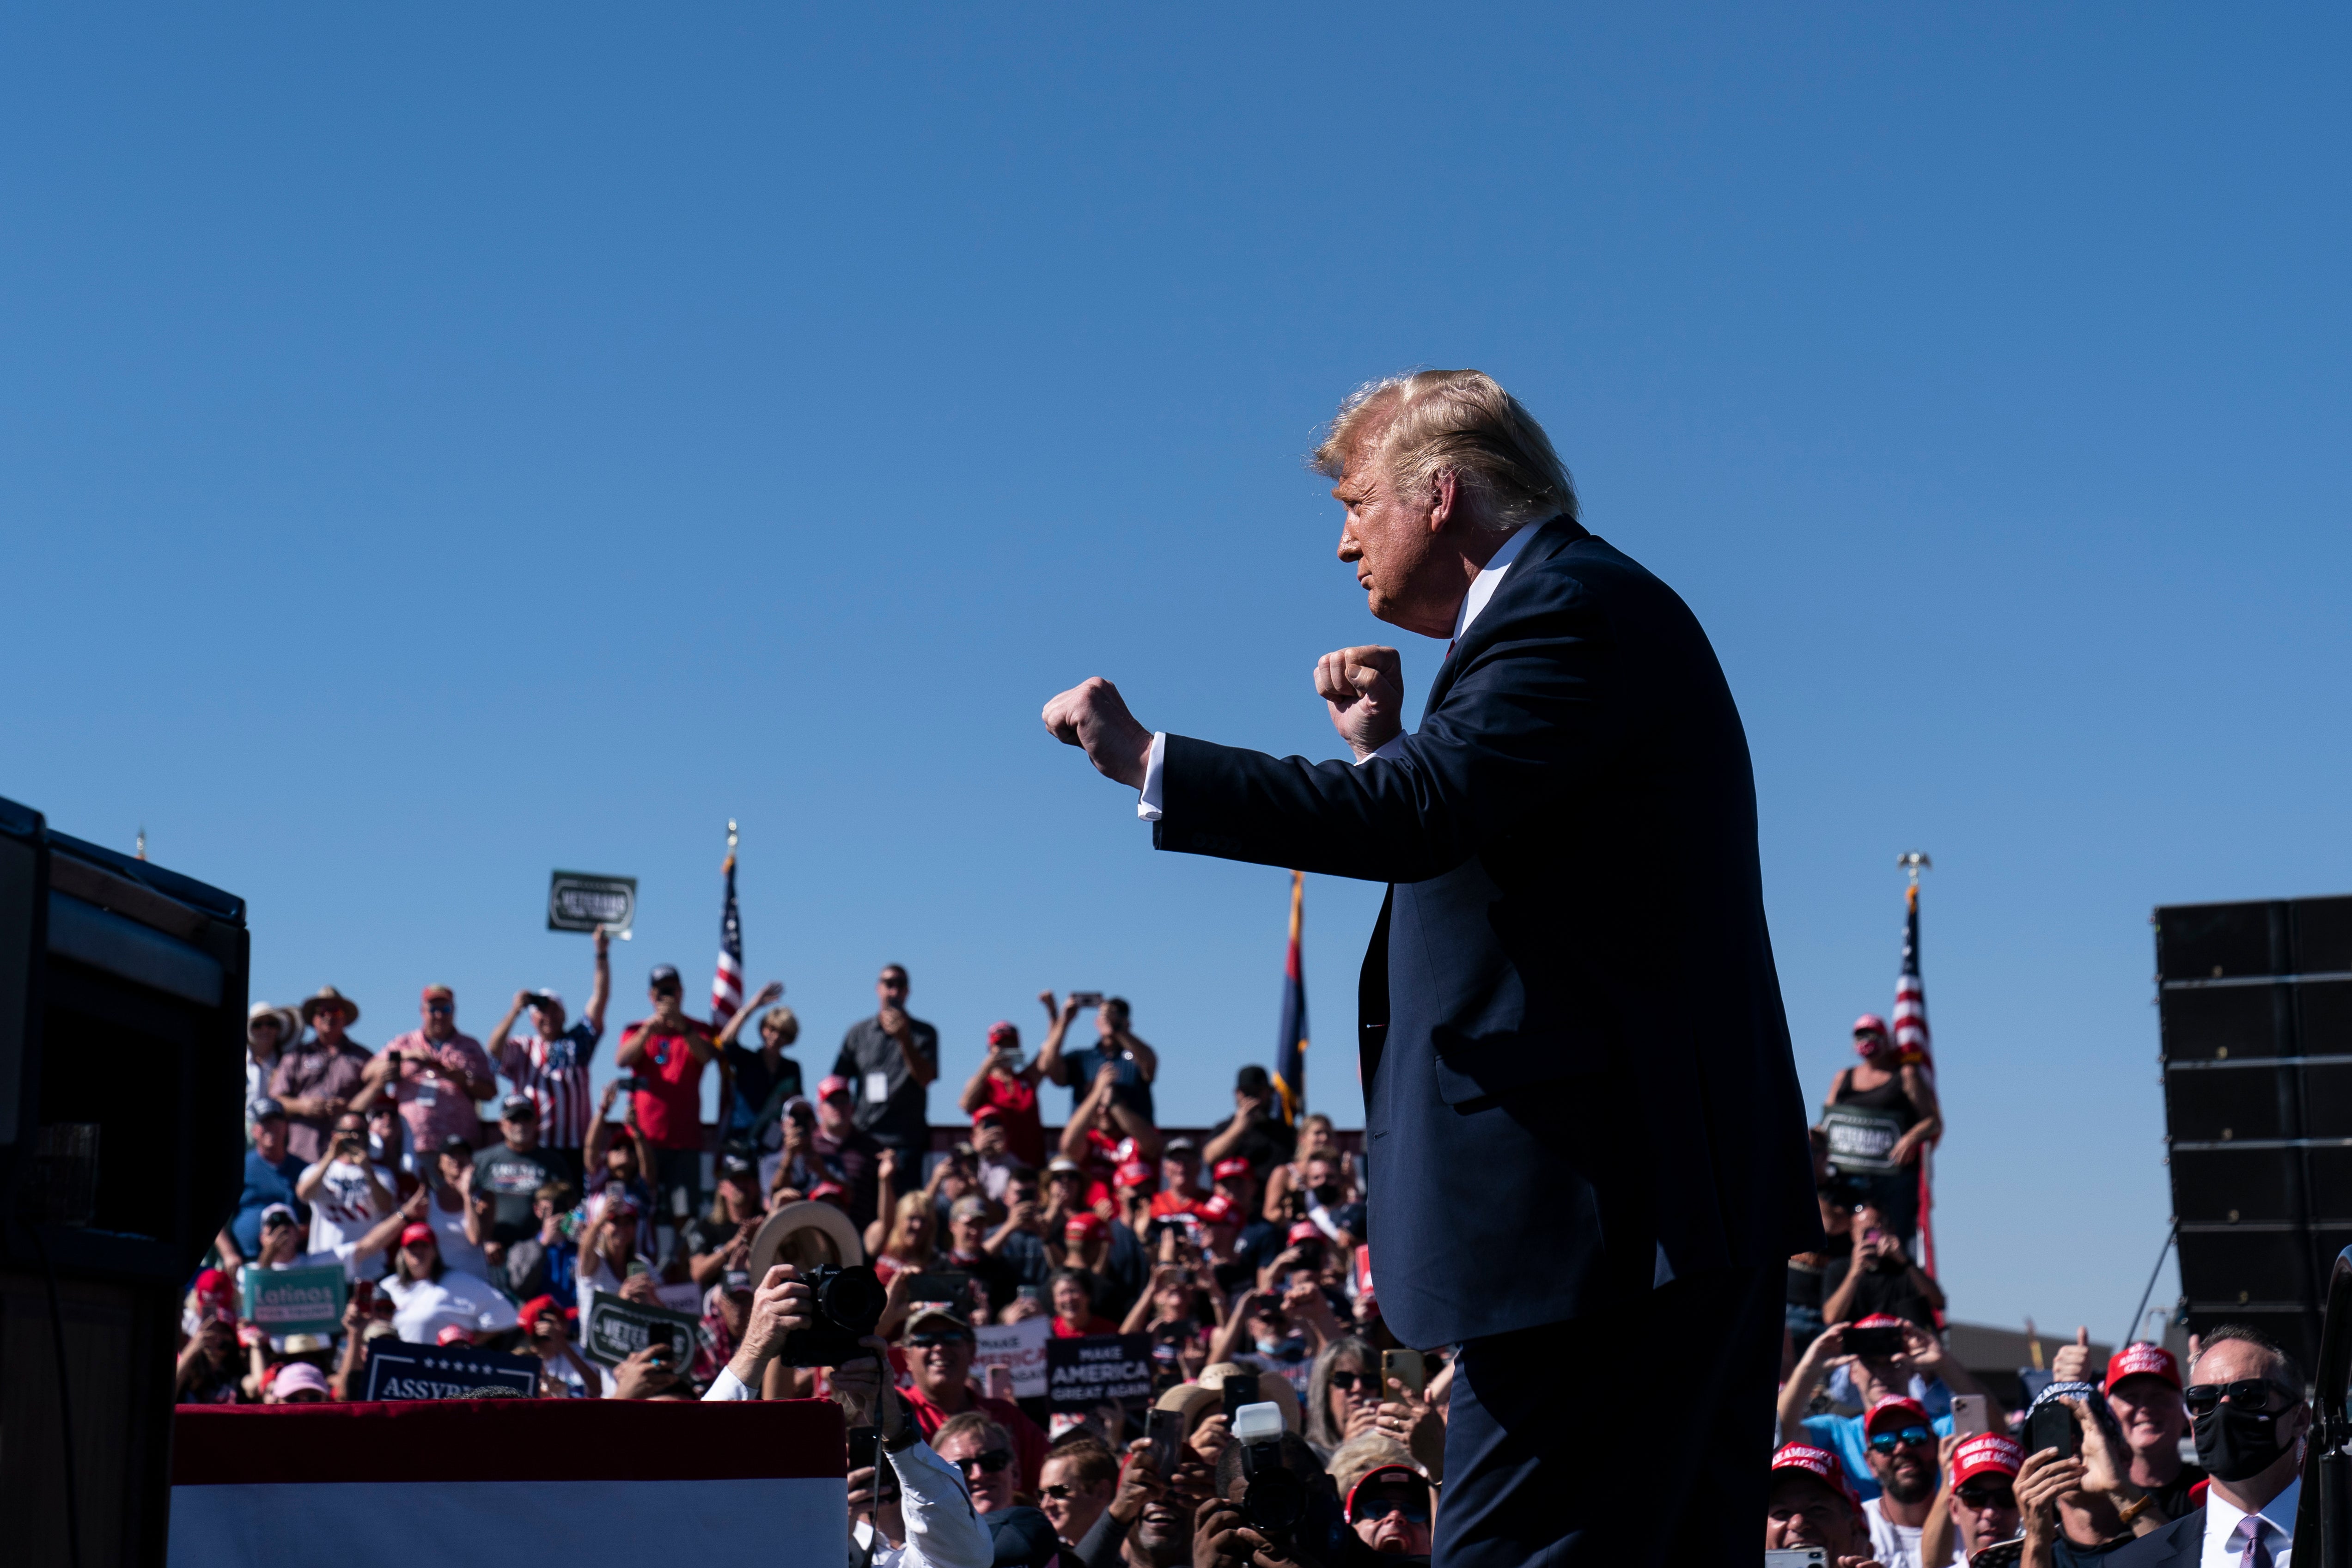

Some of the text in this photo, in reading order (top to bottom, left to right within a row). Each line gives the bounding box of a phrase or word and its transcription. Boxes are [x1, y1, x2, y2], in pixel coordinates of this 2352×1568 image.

[255, 1285, 333, 1305] Latinos
[1079, 1345, 1123, 1361] MAKE
[2118, 1352, 2168, 1367] AMERICA
[1051, 1361, 1150, 1385] AMERICA
[1051, 1381, 1151, 1401] GREAT AGAIN
[1784, 1446, 1833, 1467] AMERICA
[1957, 1438, 2024, 1459] MAKE AMERICA
[1962, 1450, 1993, 1470] GREAT
